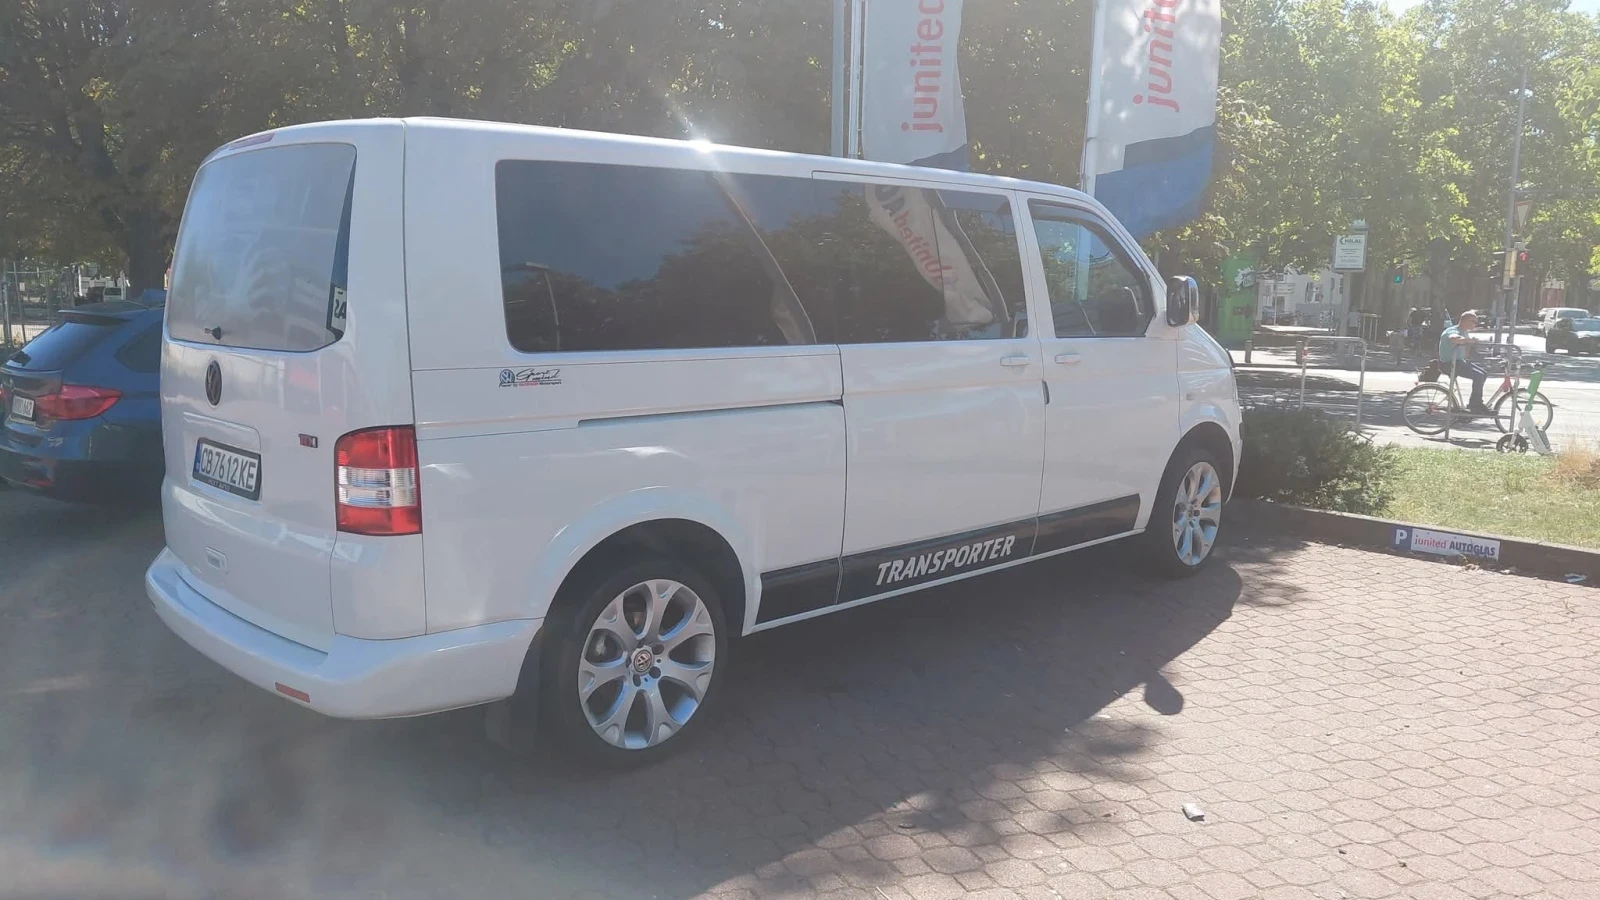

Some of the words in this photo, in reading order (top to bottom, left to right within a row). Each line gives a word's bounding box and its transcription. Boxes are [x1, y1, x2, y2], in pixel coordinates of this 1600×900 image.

[201, 448, 256, 490] CB7612KE
[876, 535, 1016, 586] TRANSPORTER
[1395, 529, 1408, 545] P
[1415, 535, 1447, 549] junited
[1449, 541, 1496, 557] AUTOGLAS
